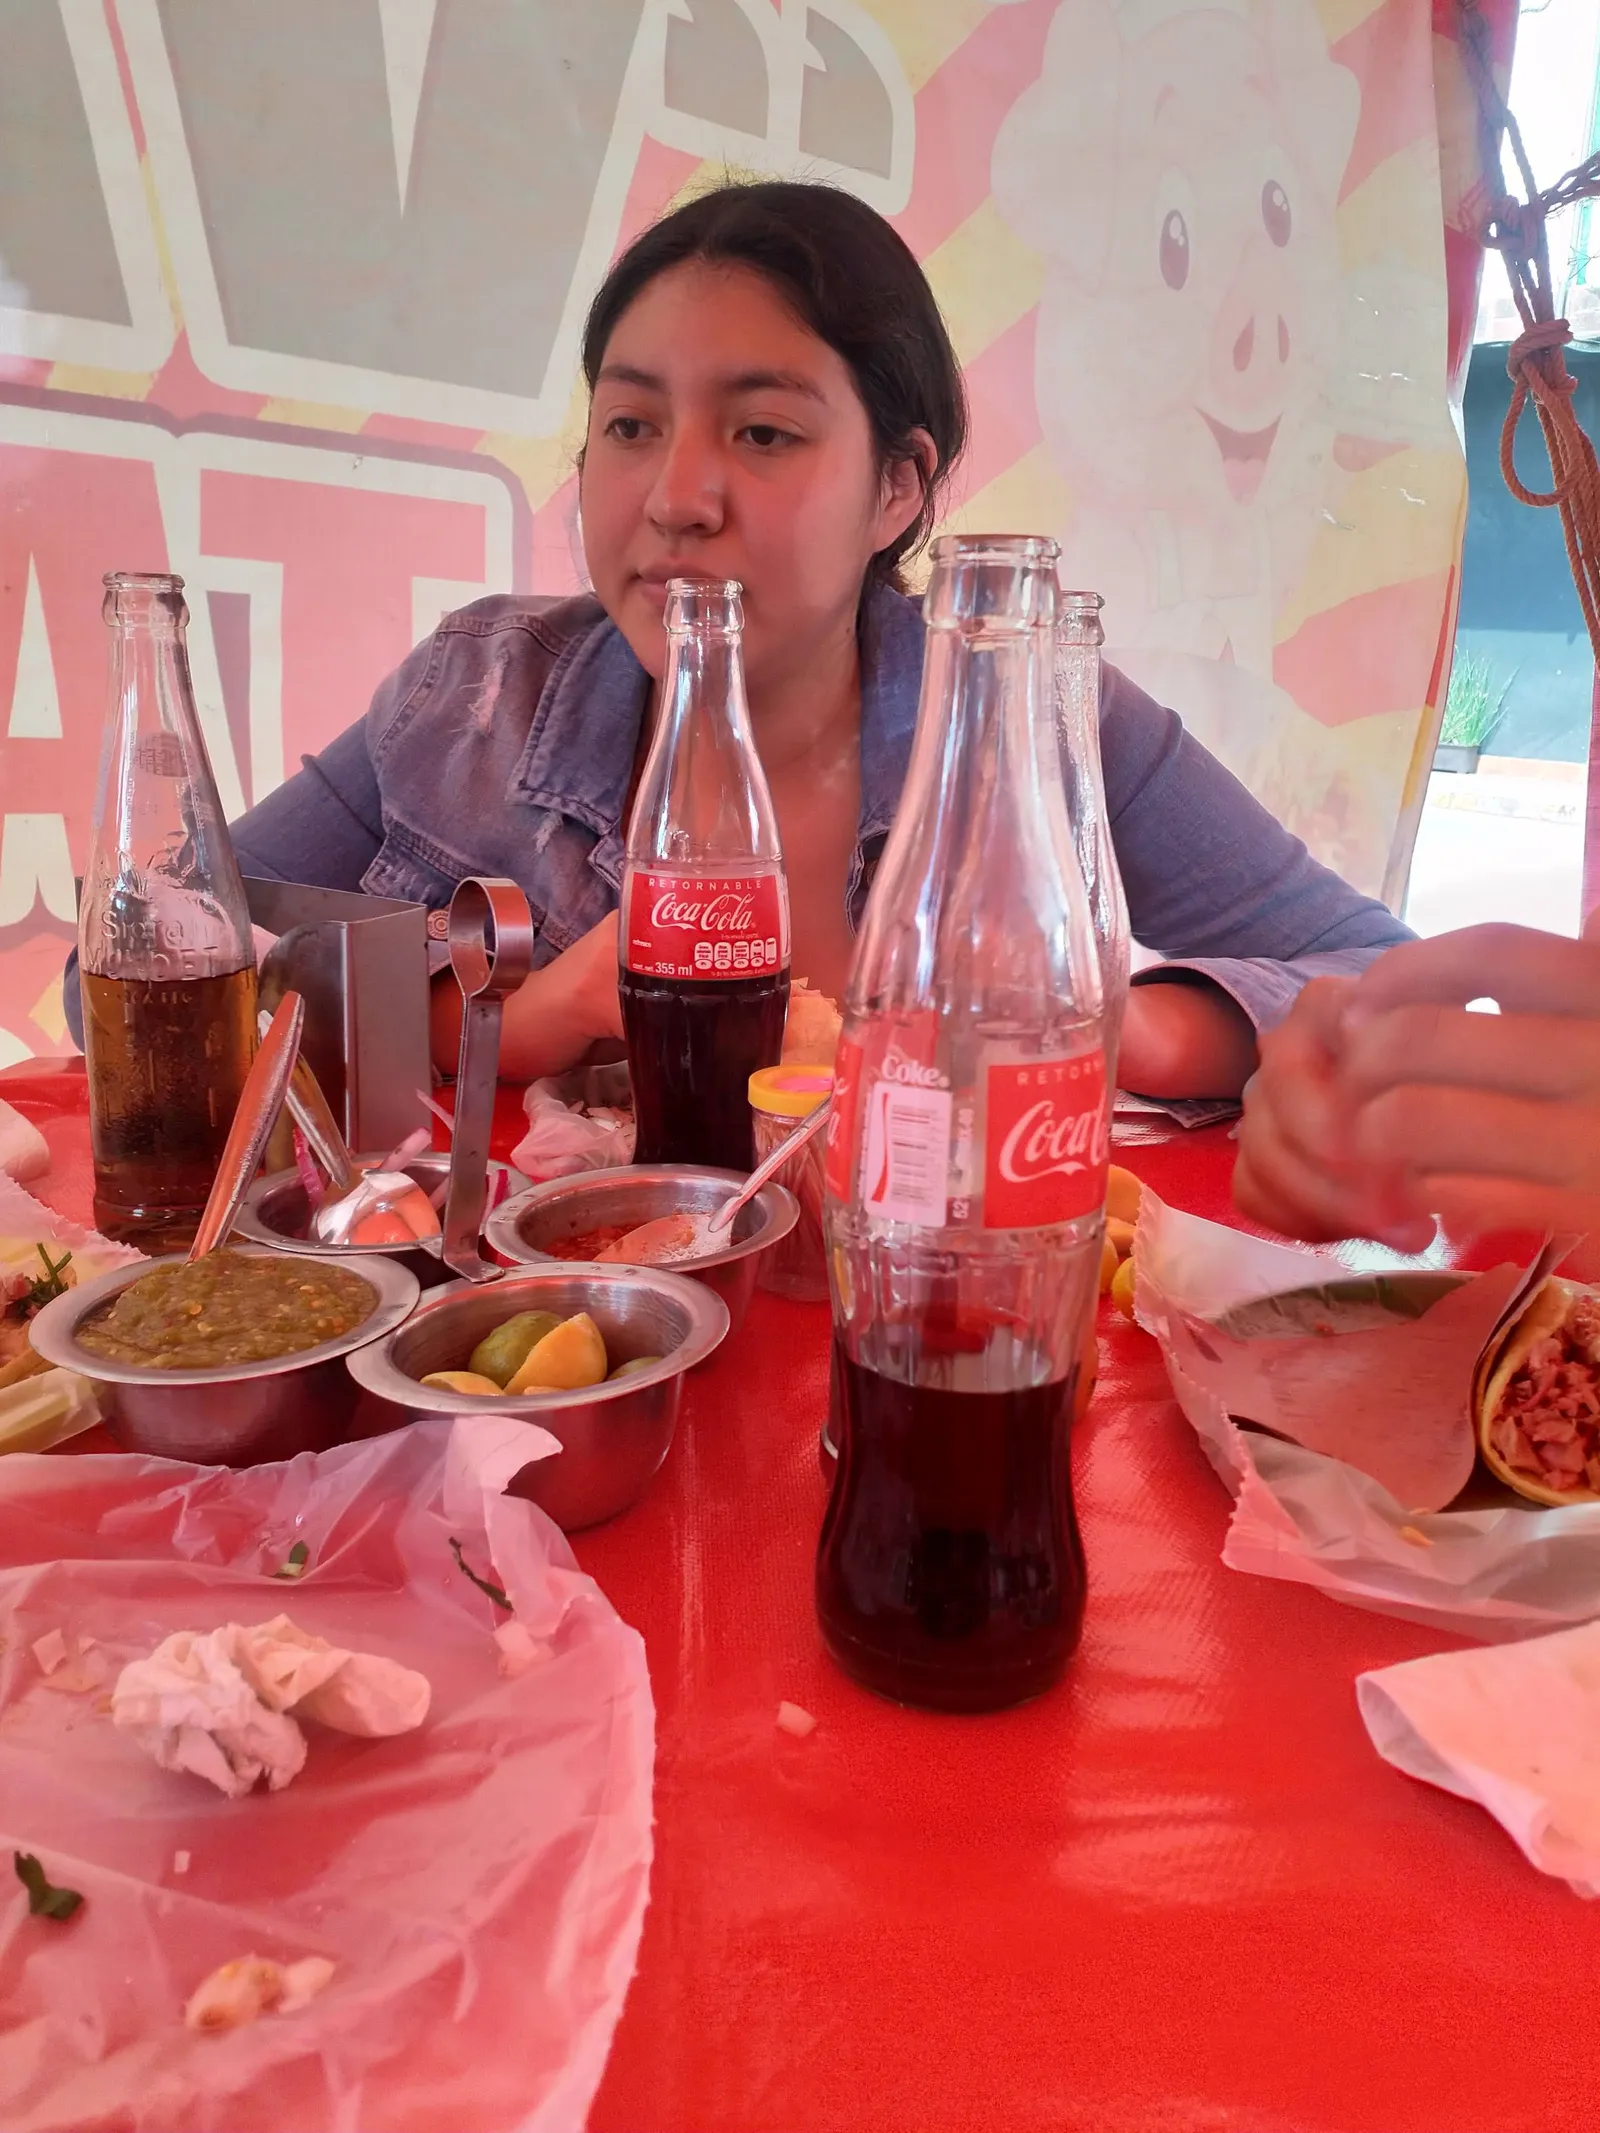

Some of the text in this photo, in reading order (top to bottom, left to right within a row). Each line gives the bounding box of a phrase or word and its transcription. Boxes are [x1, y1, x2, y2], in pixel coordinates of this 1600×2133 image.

[648, 878, 763, 892] RETORNABLE
[651, 892, 756, 932] Coca-Cola
[655, 961, 676, 976] 355
[677, 964, 693, 977] ml
[881, 1056, 941, 1088] Coke
